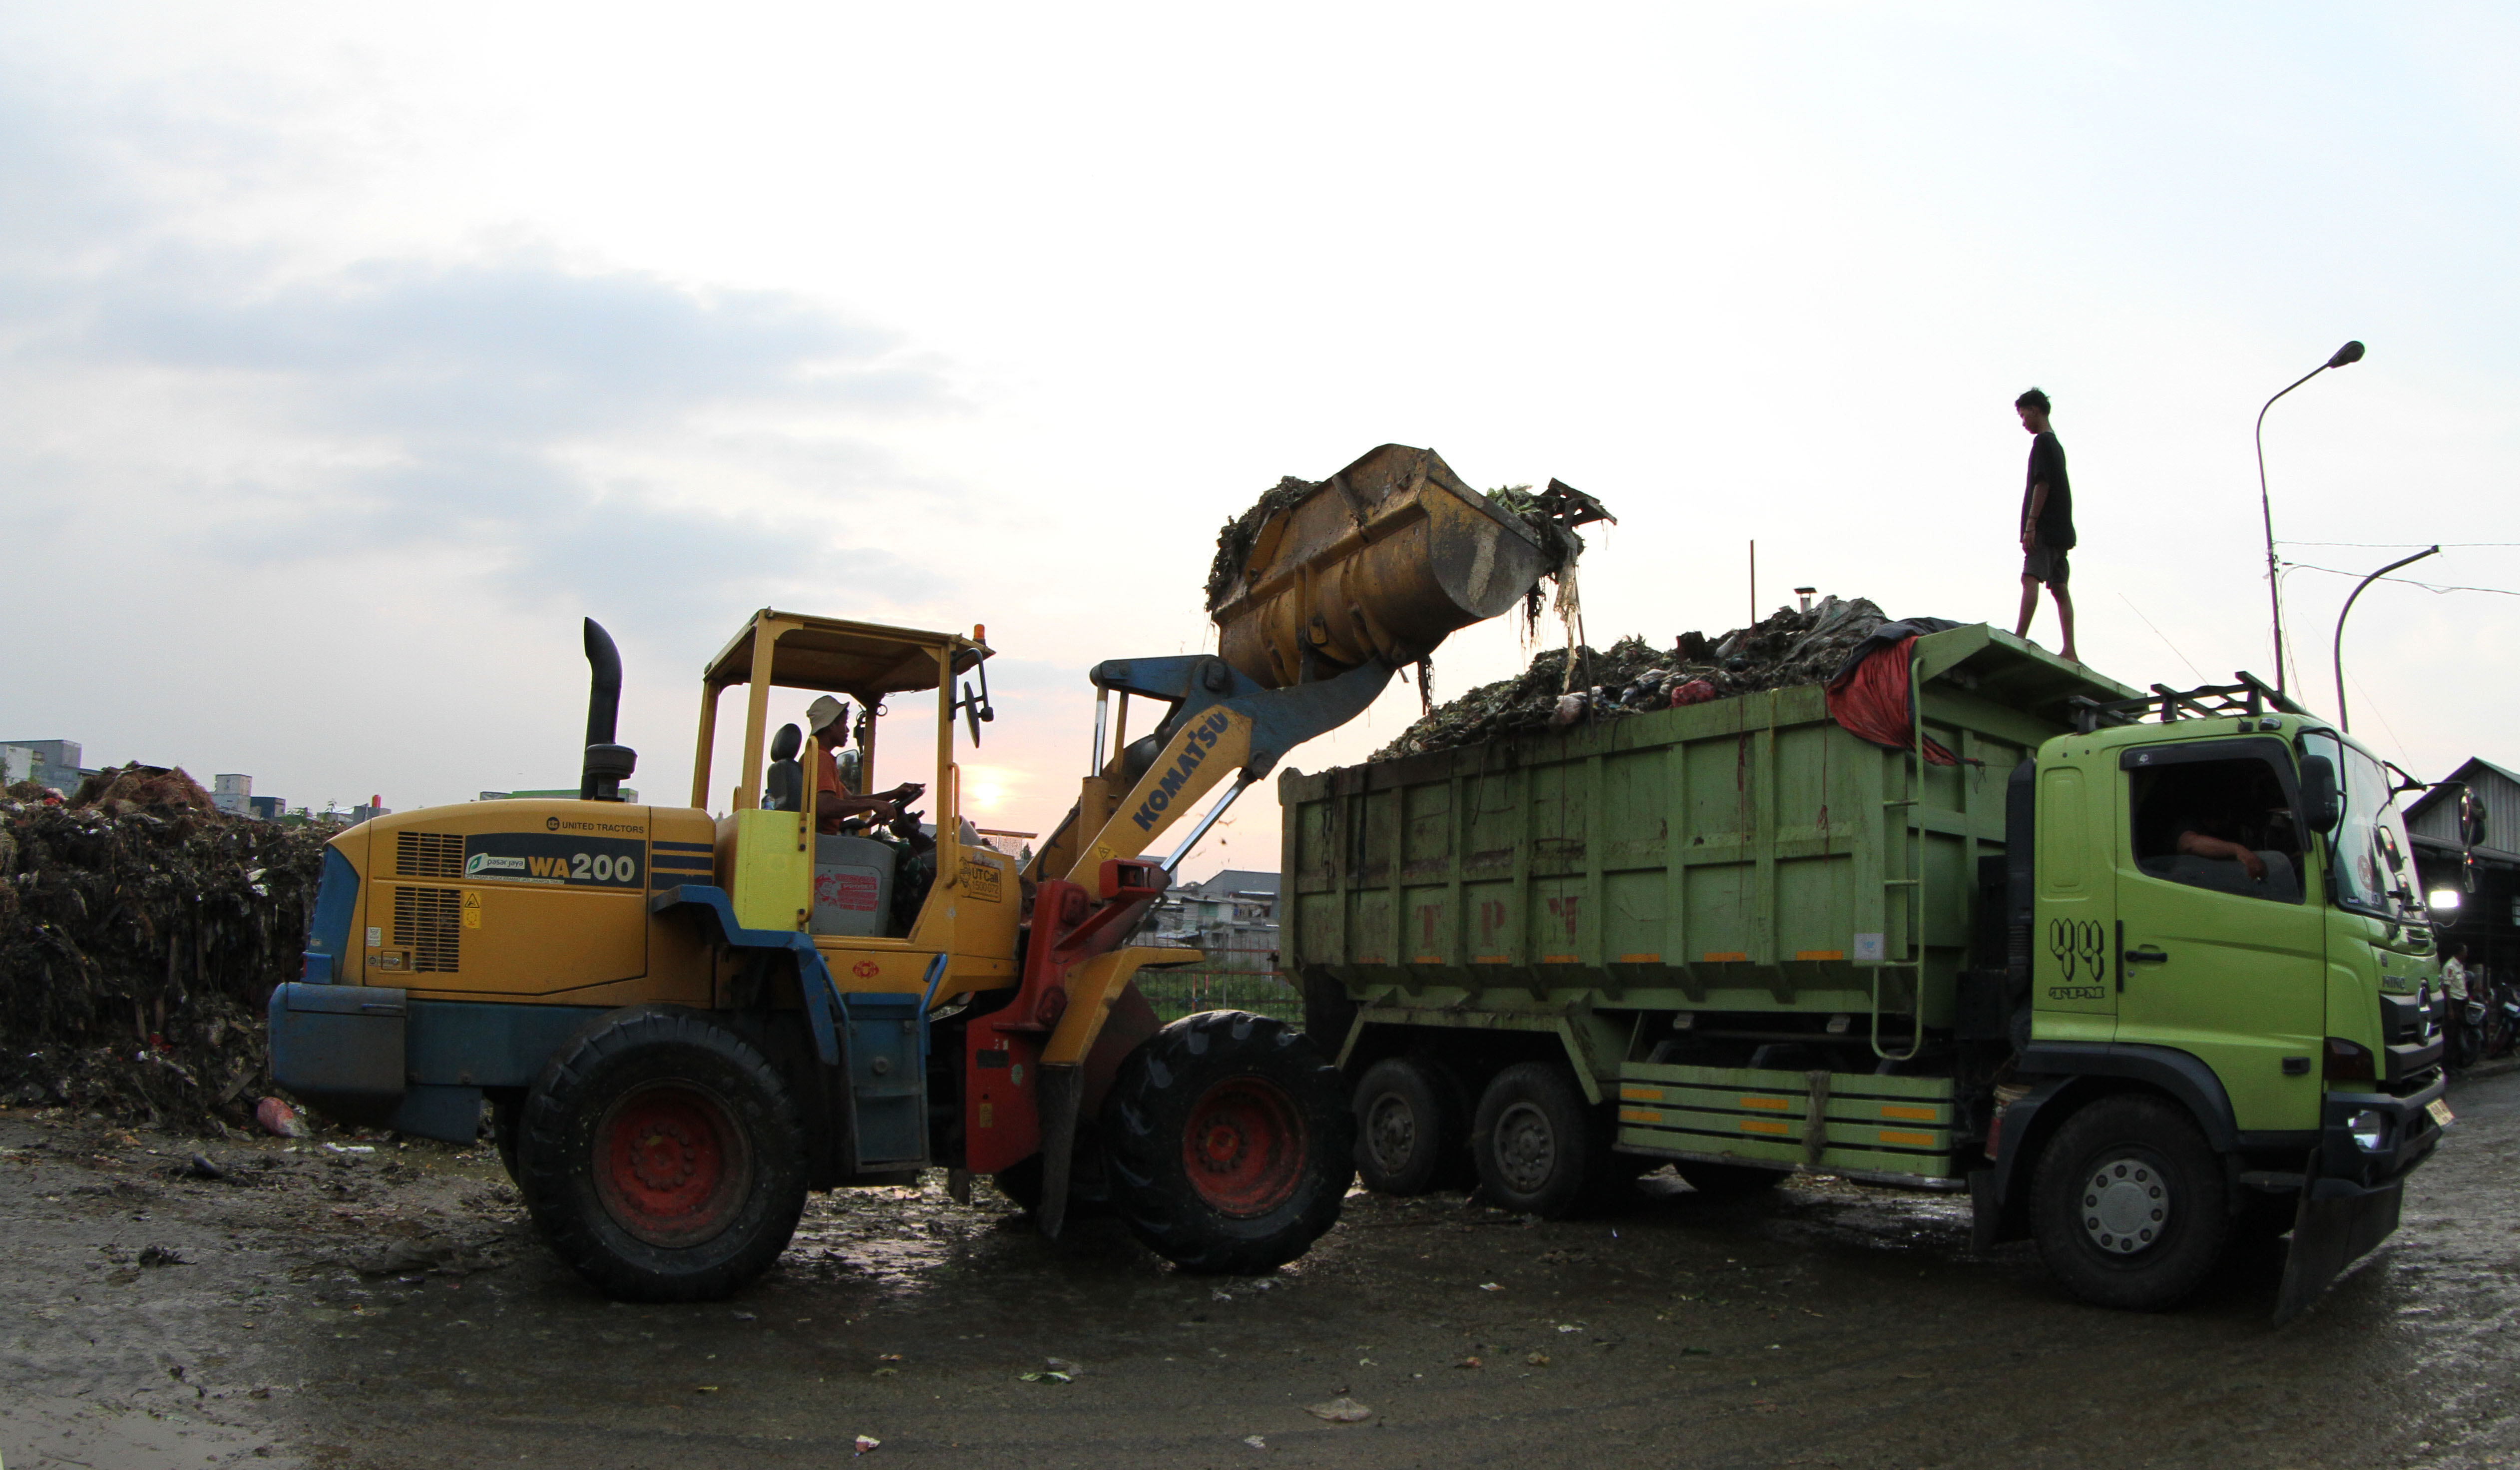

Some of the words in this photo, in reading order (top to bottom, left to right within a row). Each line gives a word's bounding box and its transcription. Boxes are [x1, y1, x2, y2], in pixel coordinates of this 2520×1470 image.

[1132, 712, 1229, 832] KOMATSU
[562, 821, 594, 830] UNITED
[596, 824, 644, 834] TRACTORS
[527, 853, 635, 882] WA200
[972, 868, 983, 880] UT
[984, 870, 999, 883] Call
[2049, 986, 2105, 999] TPM
